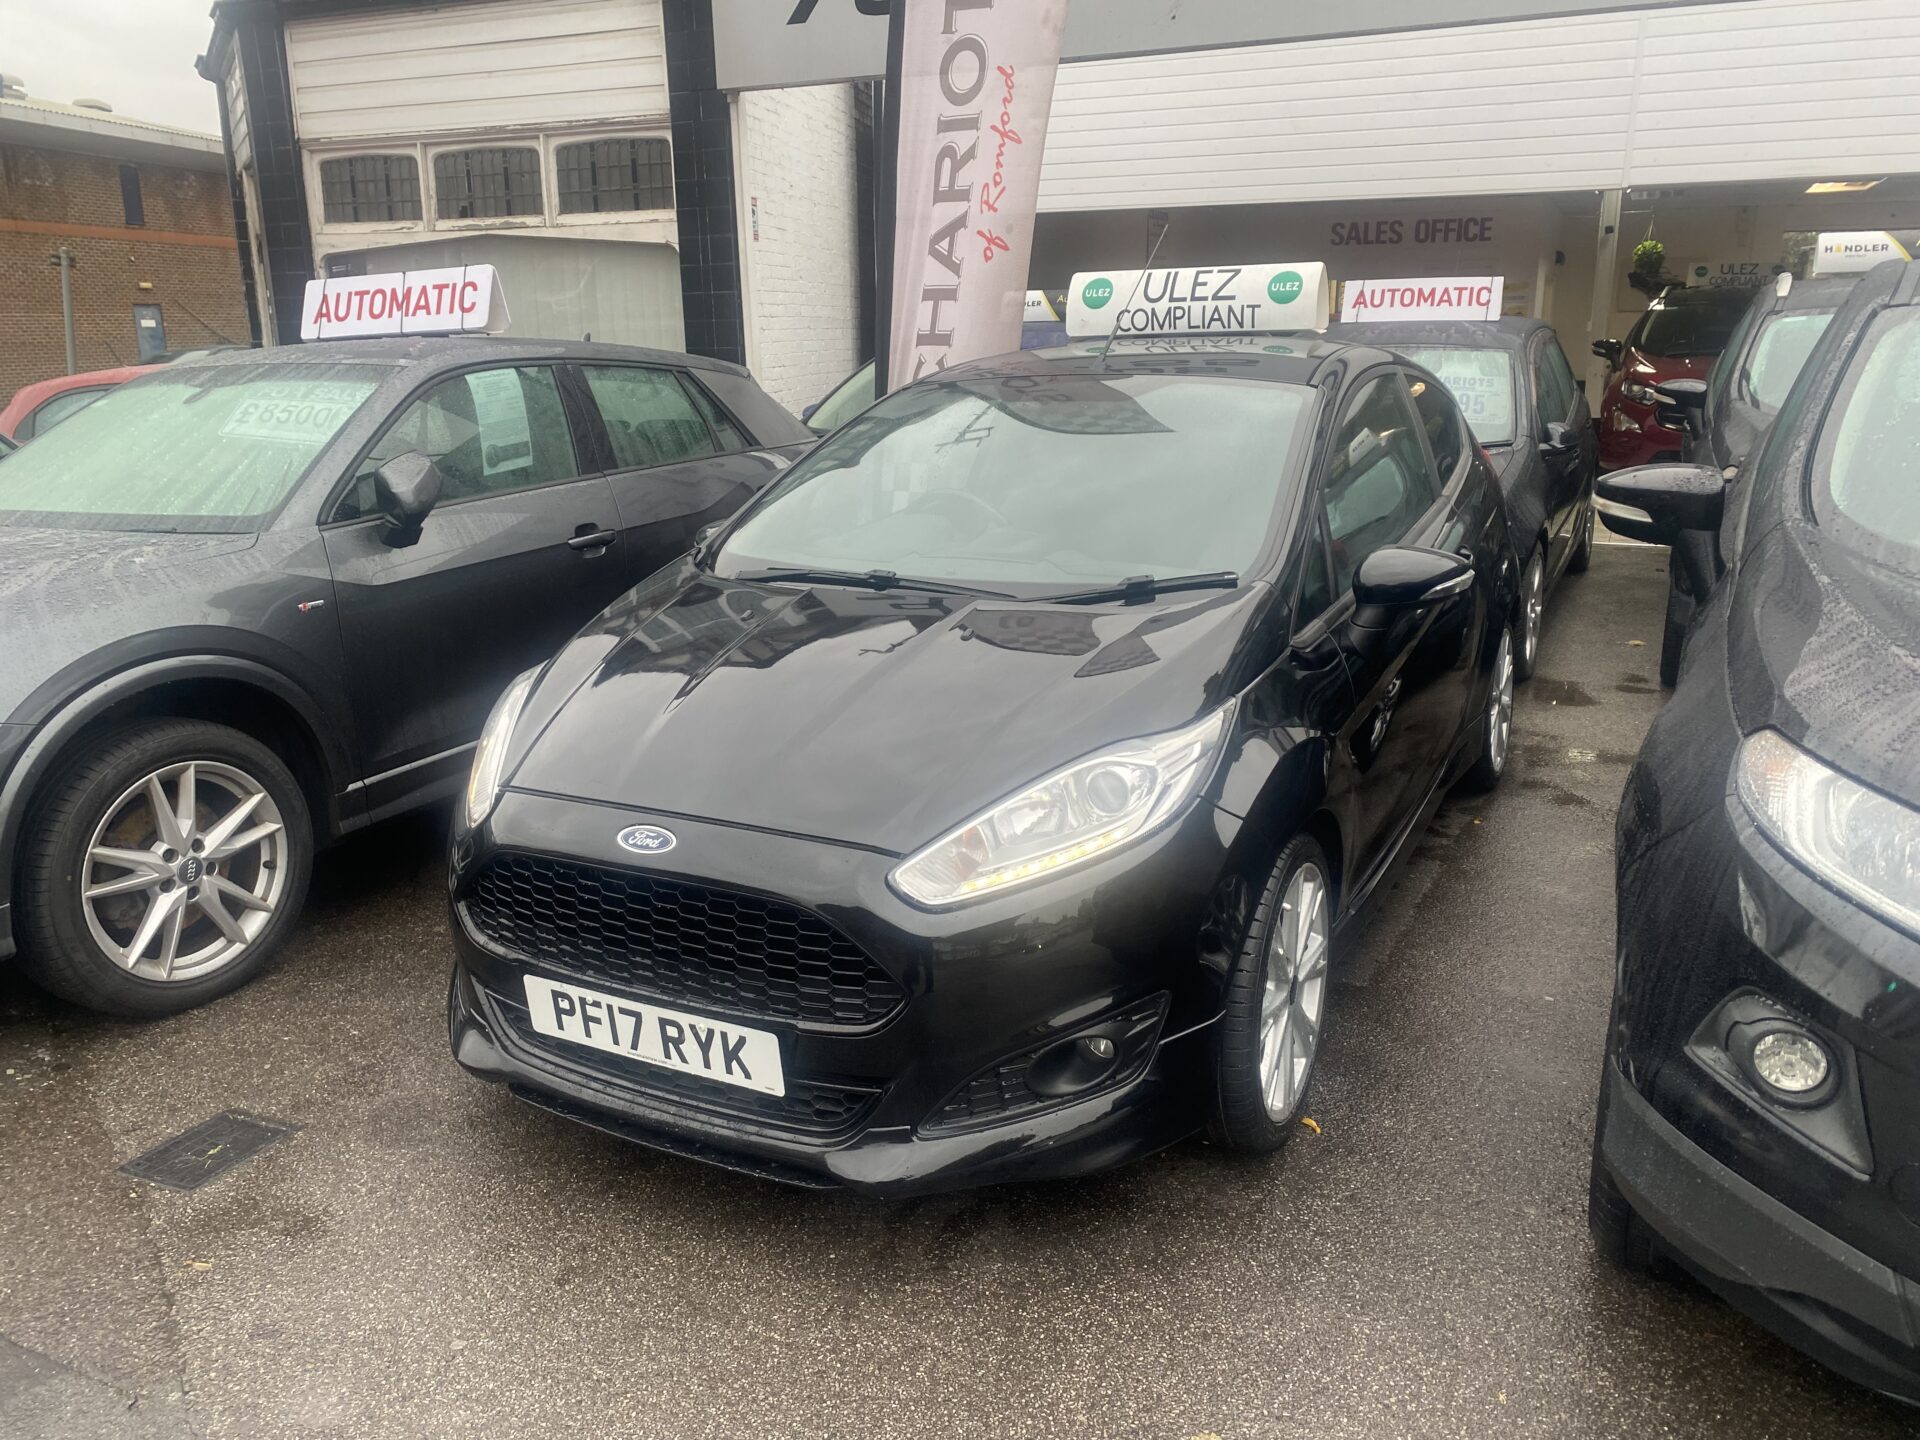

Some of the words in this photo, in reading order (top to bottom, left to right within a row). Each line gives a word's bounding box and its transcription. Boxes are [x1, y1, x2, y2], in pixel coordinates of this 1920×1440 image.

[980, 65, 1023, 215] Romford
[1330, 220, 1403, 246] SALES
[1414, 217, 1493, 243] OFFICE
[976, 229, 1010, 263] of
[1720, 263, 1759, 275] ULEZ
[1085, 287, 1111, 298] ULEZ
[1143, 268, 1242, 303] ULEZ
[1271, 281, 1300, 292] ULEZ
[1352, 286, 1492, 309] AUTOMATIC
[313, 280, 479, 324] AUTOMATIC
[1116, 304, 1261, 332] COMPLIANT
[628, 830, 664, 848] Ford
[551, 988, 643, 1051] PF17
[657, 1016, 753, 1081] RYK
